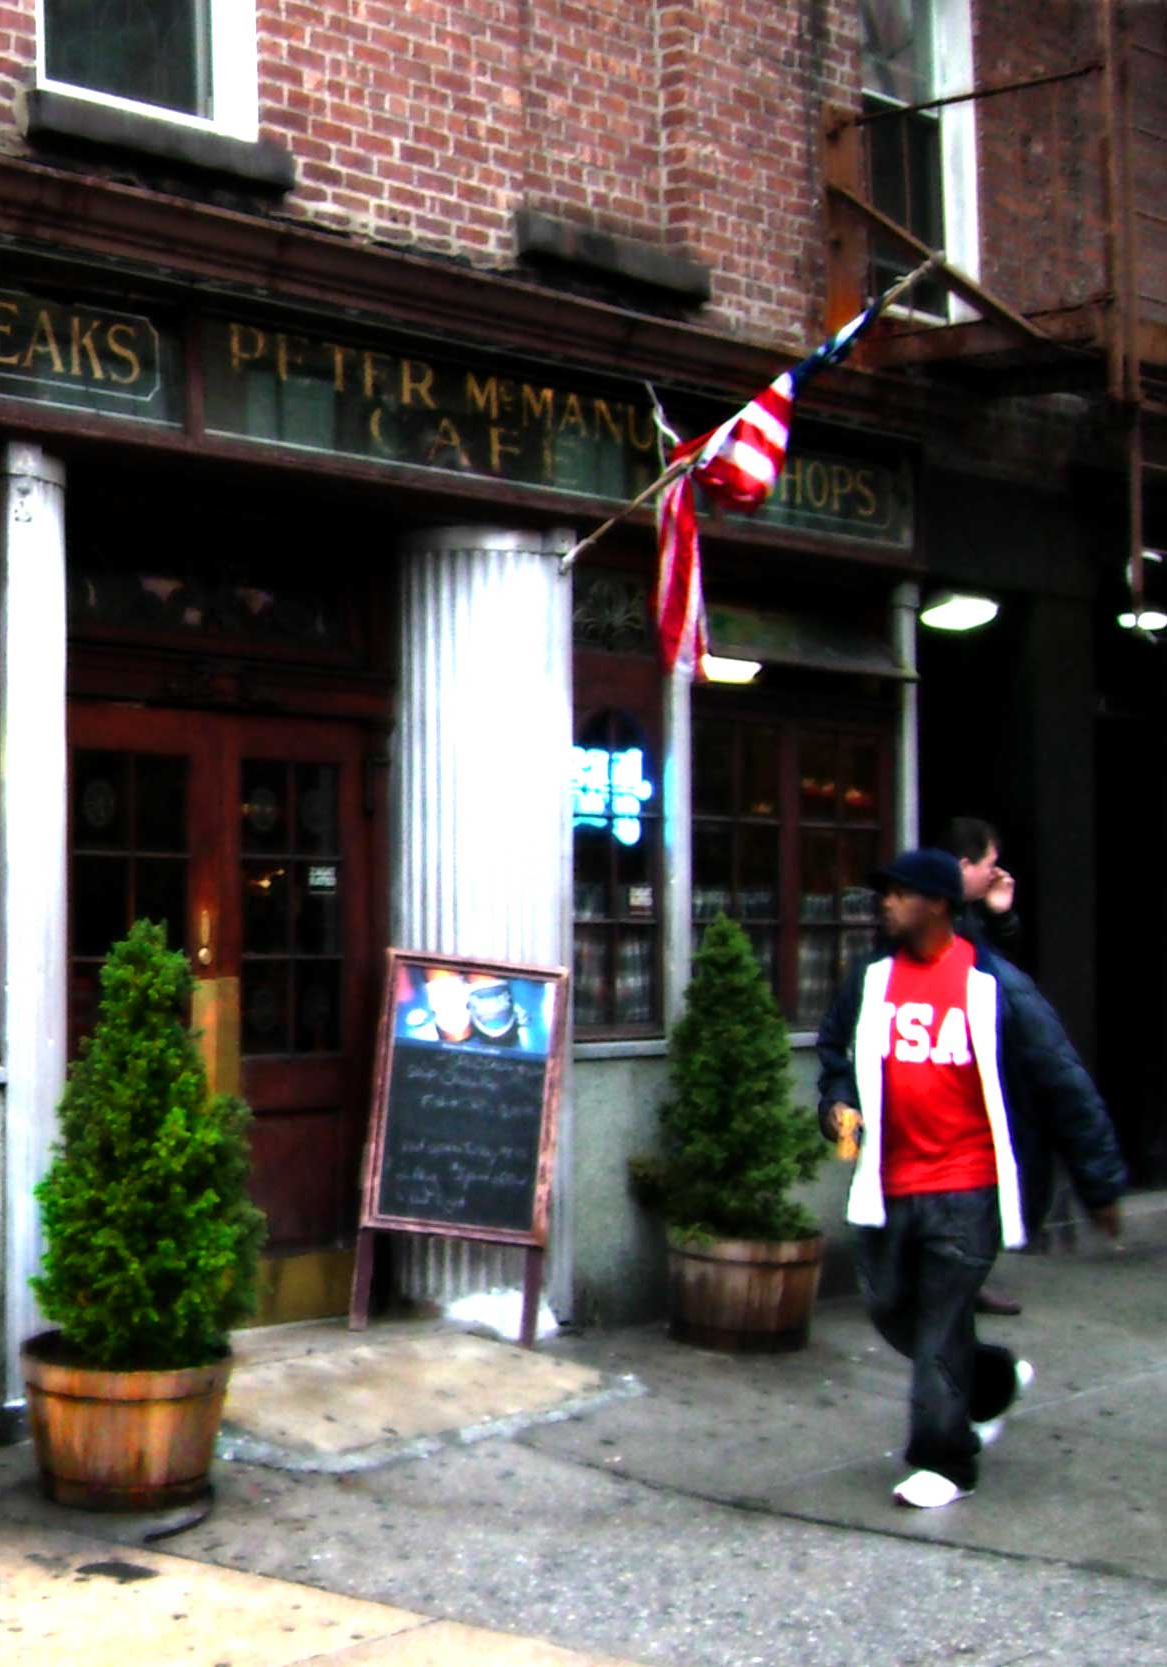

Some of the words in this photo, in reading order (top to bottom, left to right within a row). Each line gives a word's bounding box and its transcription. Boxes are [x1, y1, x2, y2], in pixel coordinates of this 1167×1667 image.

[228, 321, 439, 411] PETER
[465, 370, 657, 451] McMANU
[368, 407, 580, 486] CAFE
[779, 455, 878, 518] HOPS
